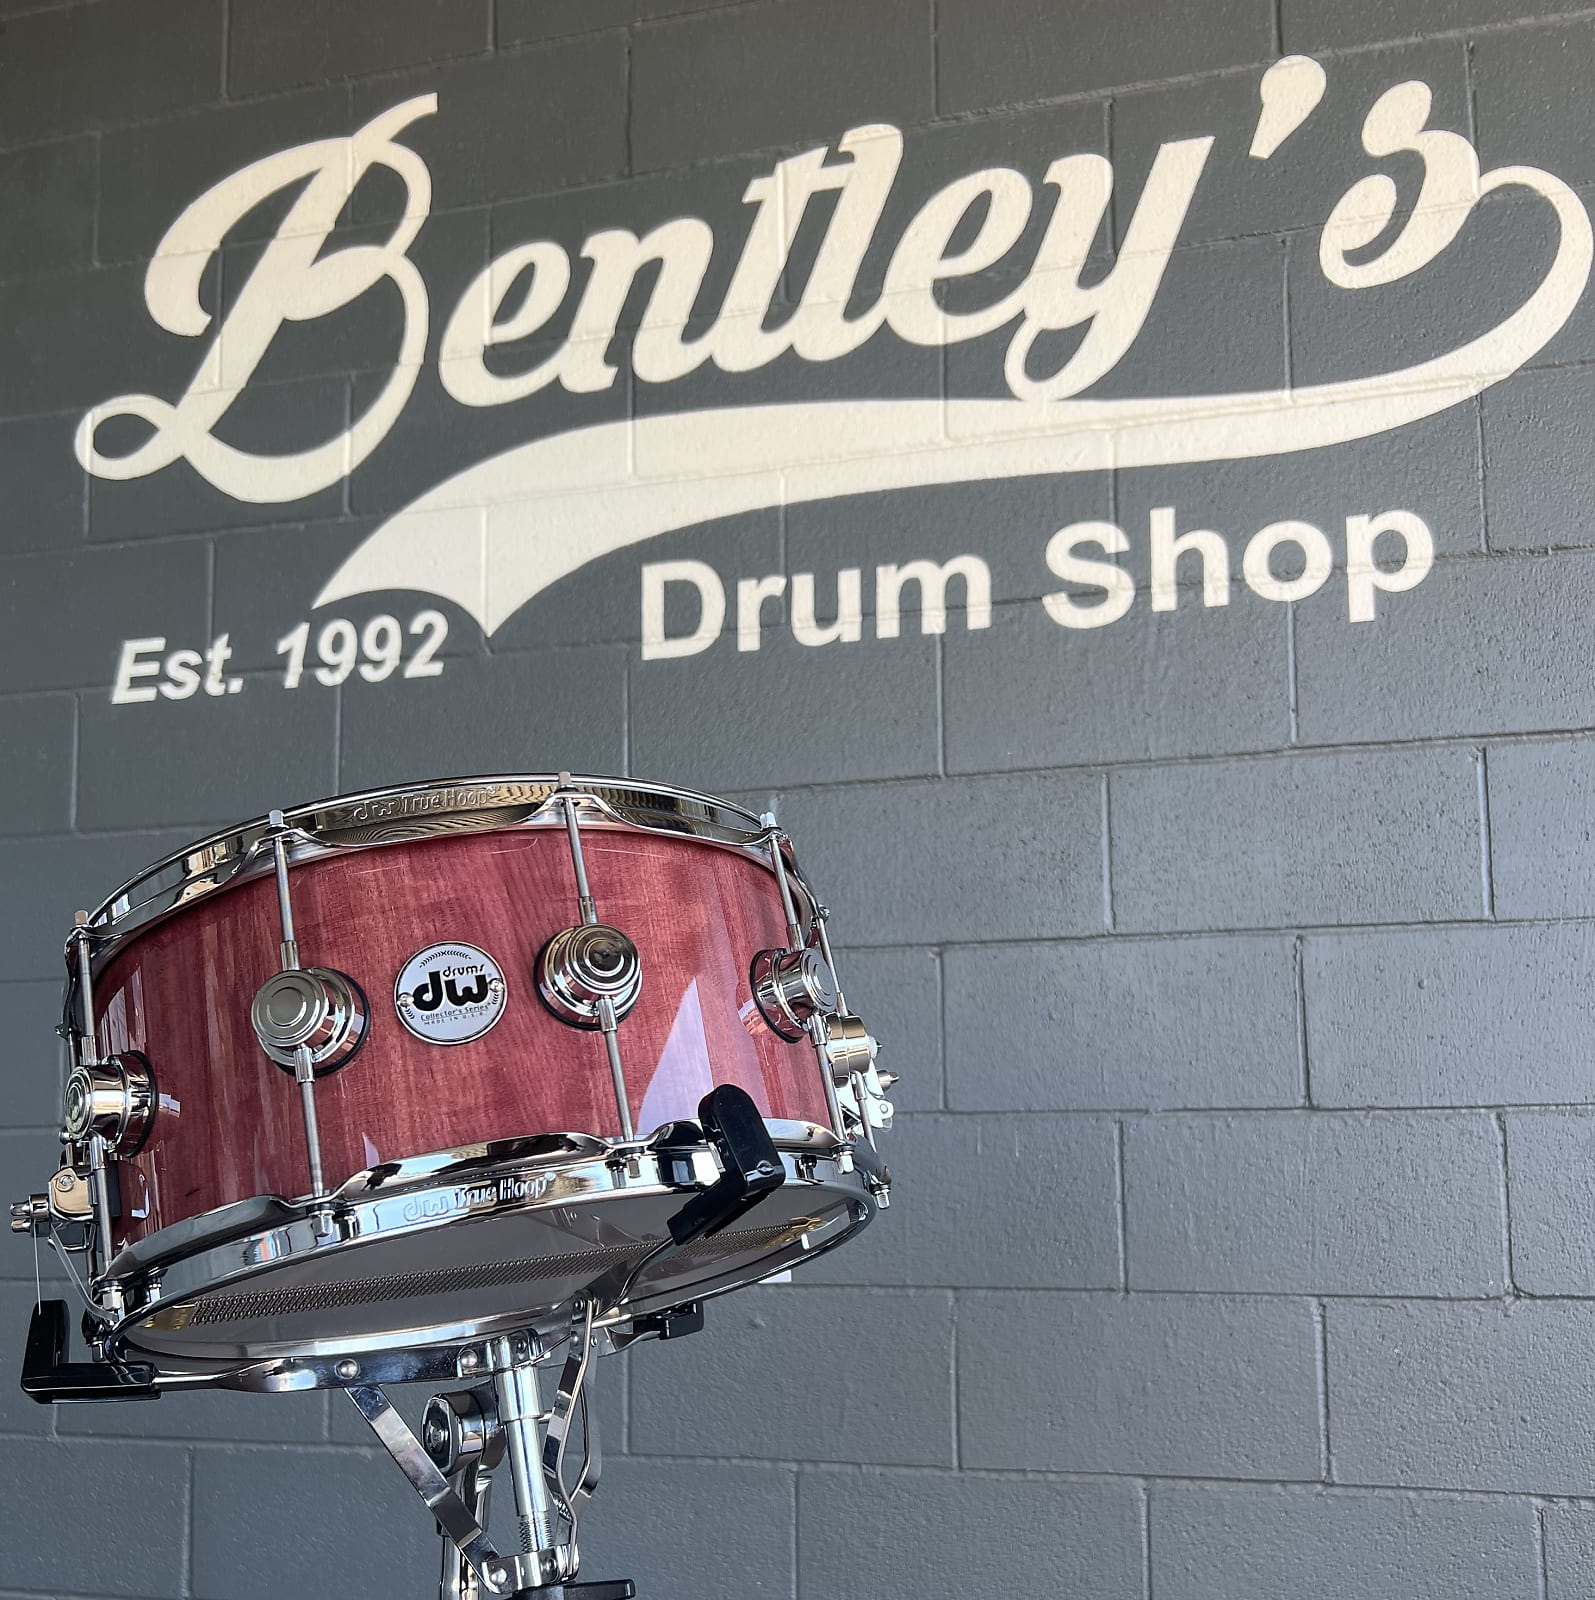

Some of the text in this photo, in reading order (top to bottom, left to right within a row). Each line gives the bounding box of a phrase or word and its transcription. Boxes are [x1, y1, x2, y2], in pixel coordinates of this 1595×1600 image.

[74, 55, 1594, 504] Bentley's
[641, 506, 1437, 661] Drum Shop
[111, 611, 449, 704] Est. 1992
[401, 793, 440, 813] True
[442, 964, 485, 978] drums
[412, 970, 488, 1012] dw
[420, 1009, 462, 1021] Collector's
[453, 1184, 497, 1210] True
